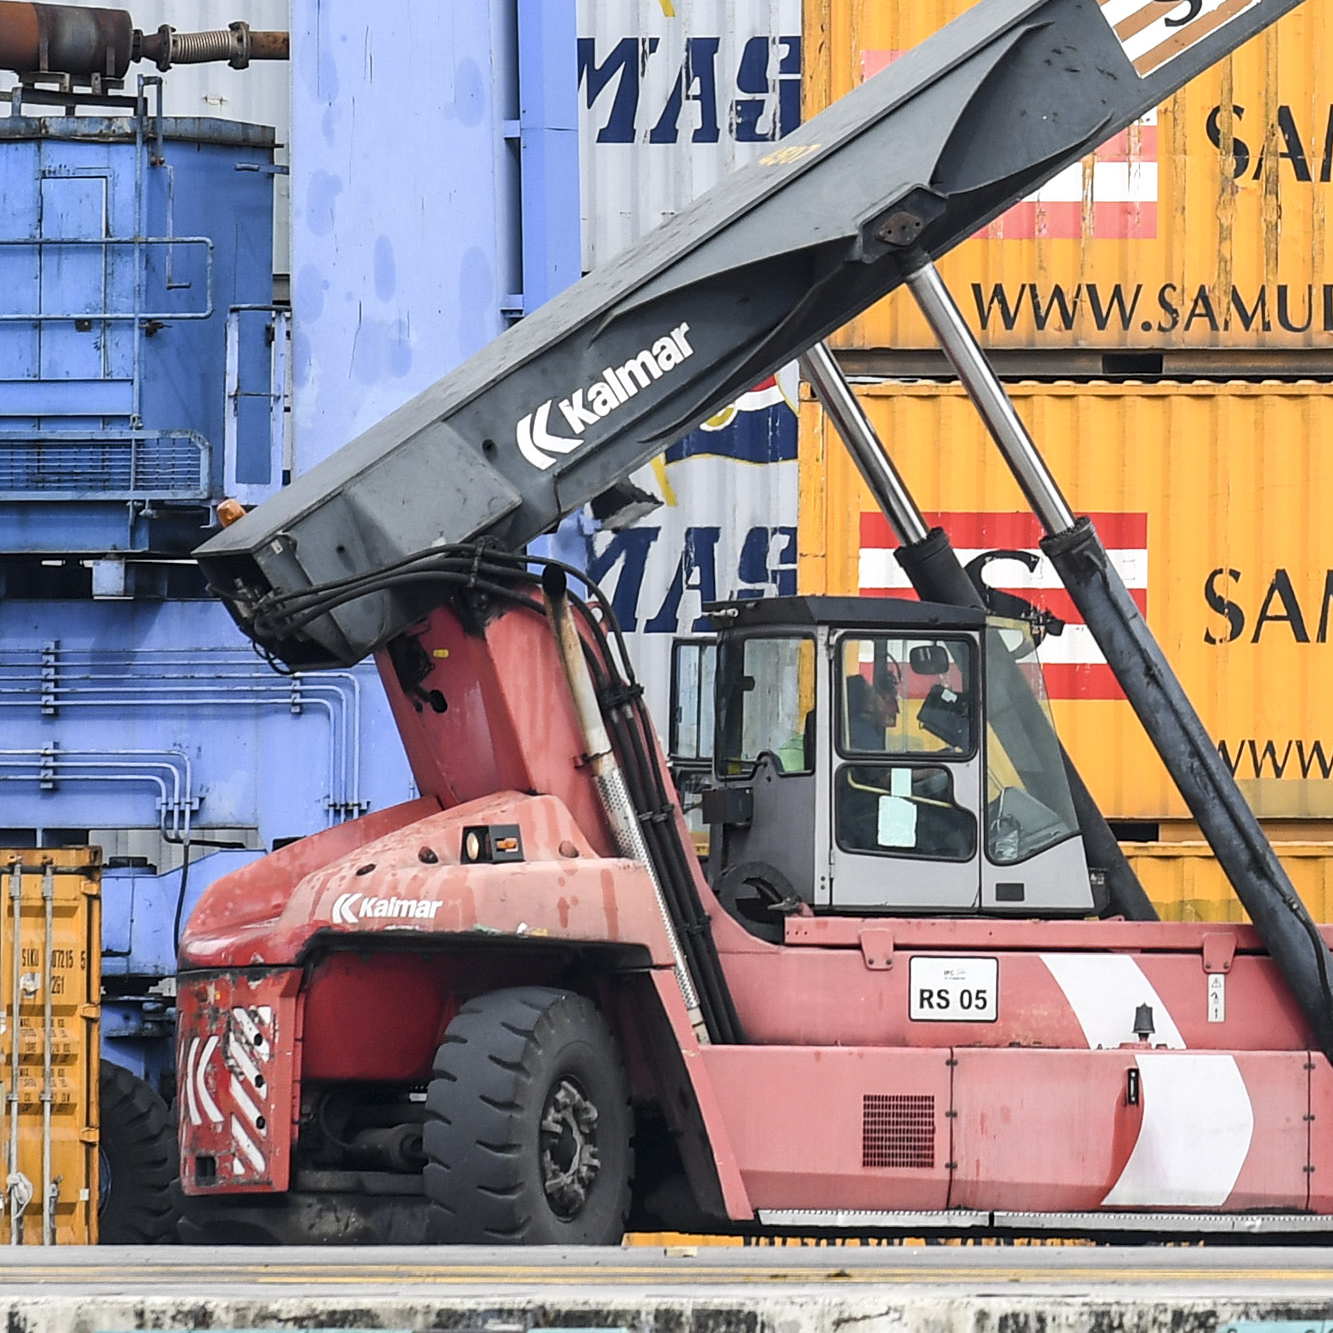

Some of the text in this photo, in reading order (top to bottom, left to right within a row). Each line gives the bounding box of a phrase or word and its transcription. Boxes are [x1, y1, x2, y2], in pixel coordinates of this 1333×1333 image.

[577, 36, 803, 143] MAS
[559, 321, 697, 435] Kalmar
[586, 525, 799, 634] MAS
[359, 896, 443, 920] Kalmar
[22, 948, 40, 967] SIKU
[919, 988, 988, 1011] RS 05
